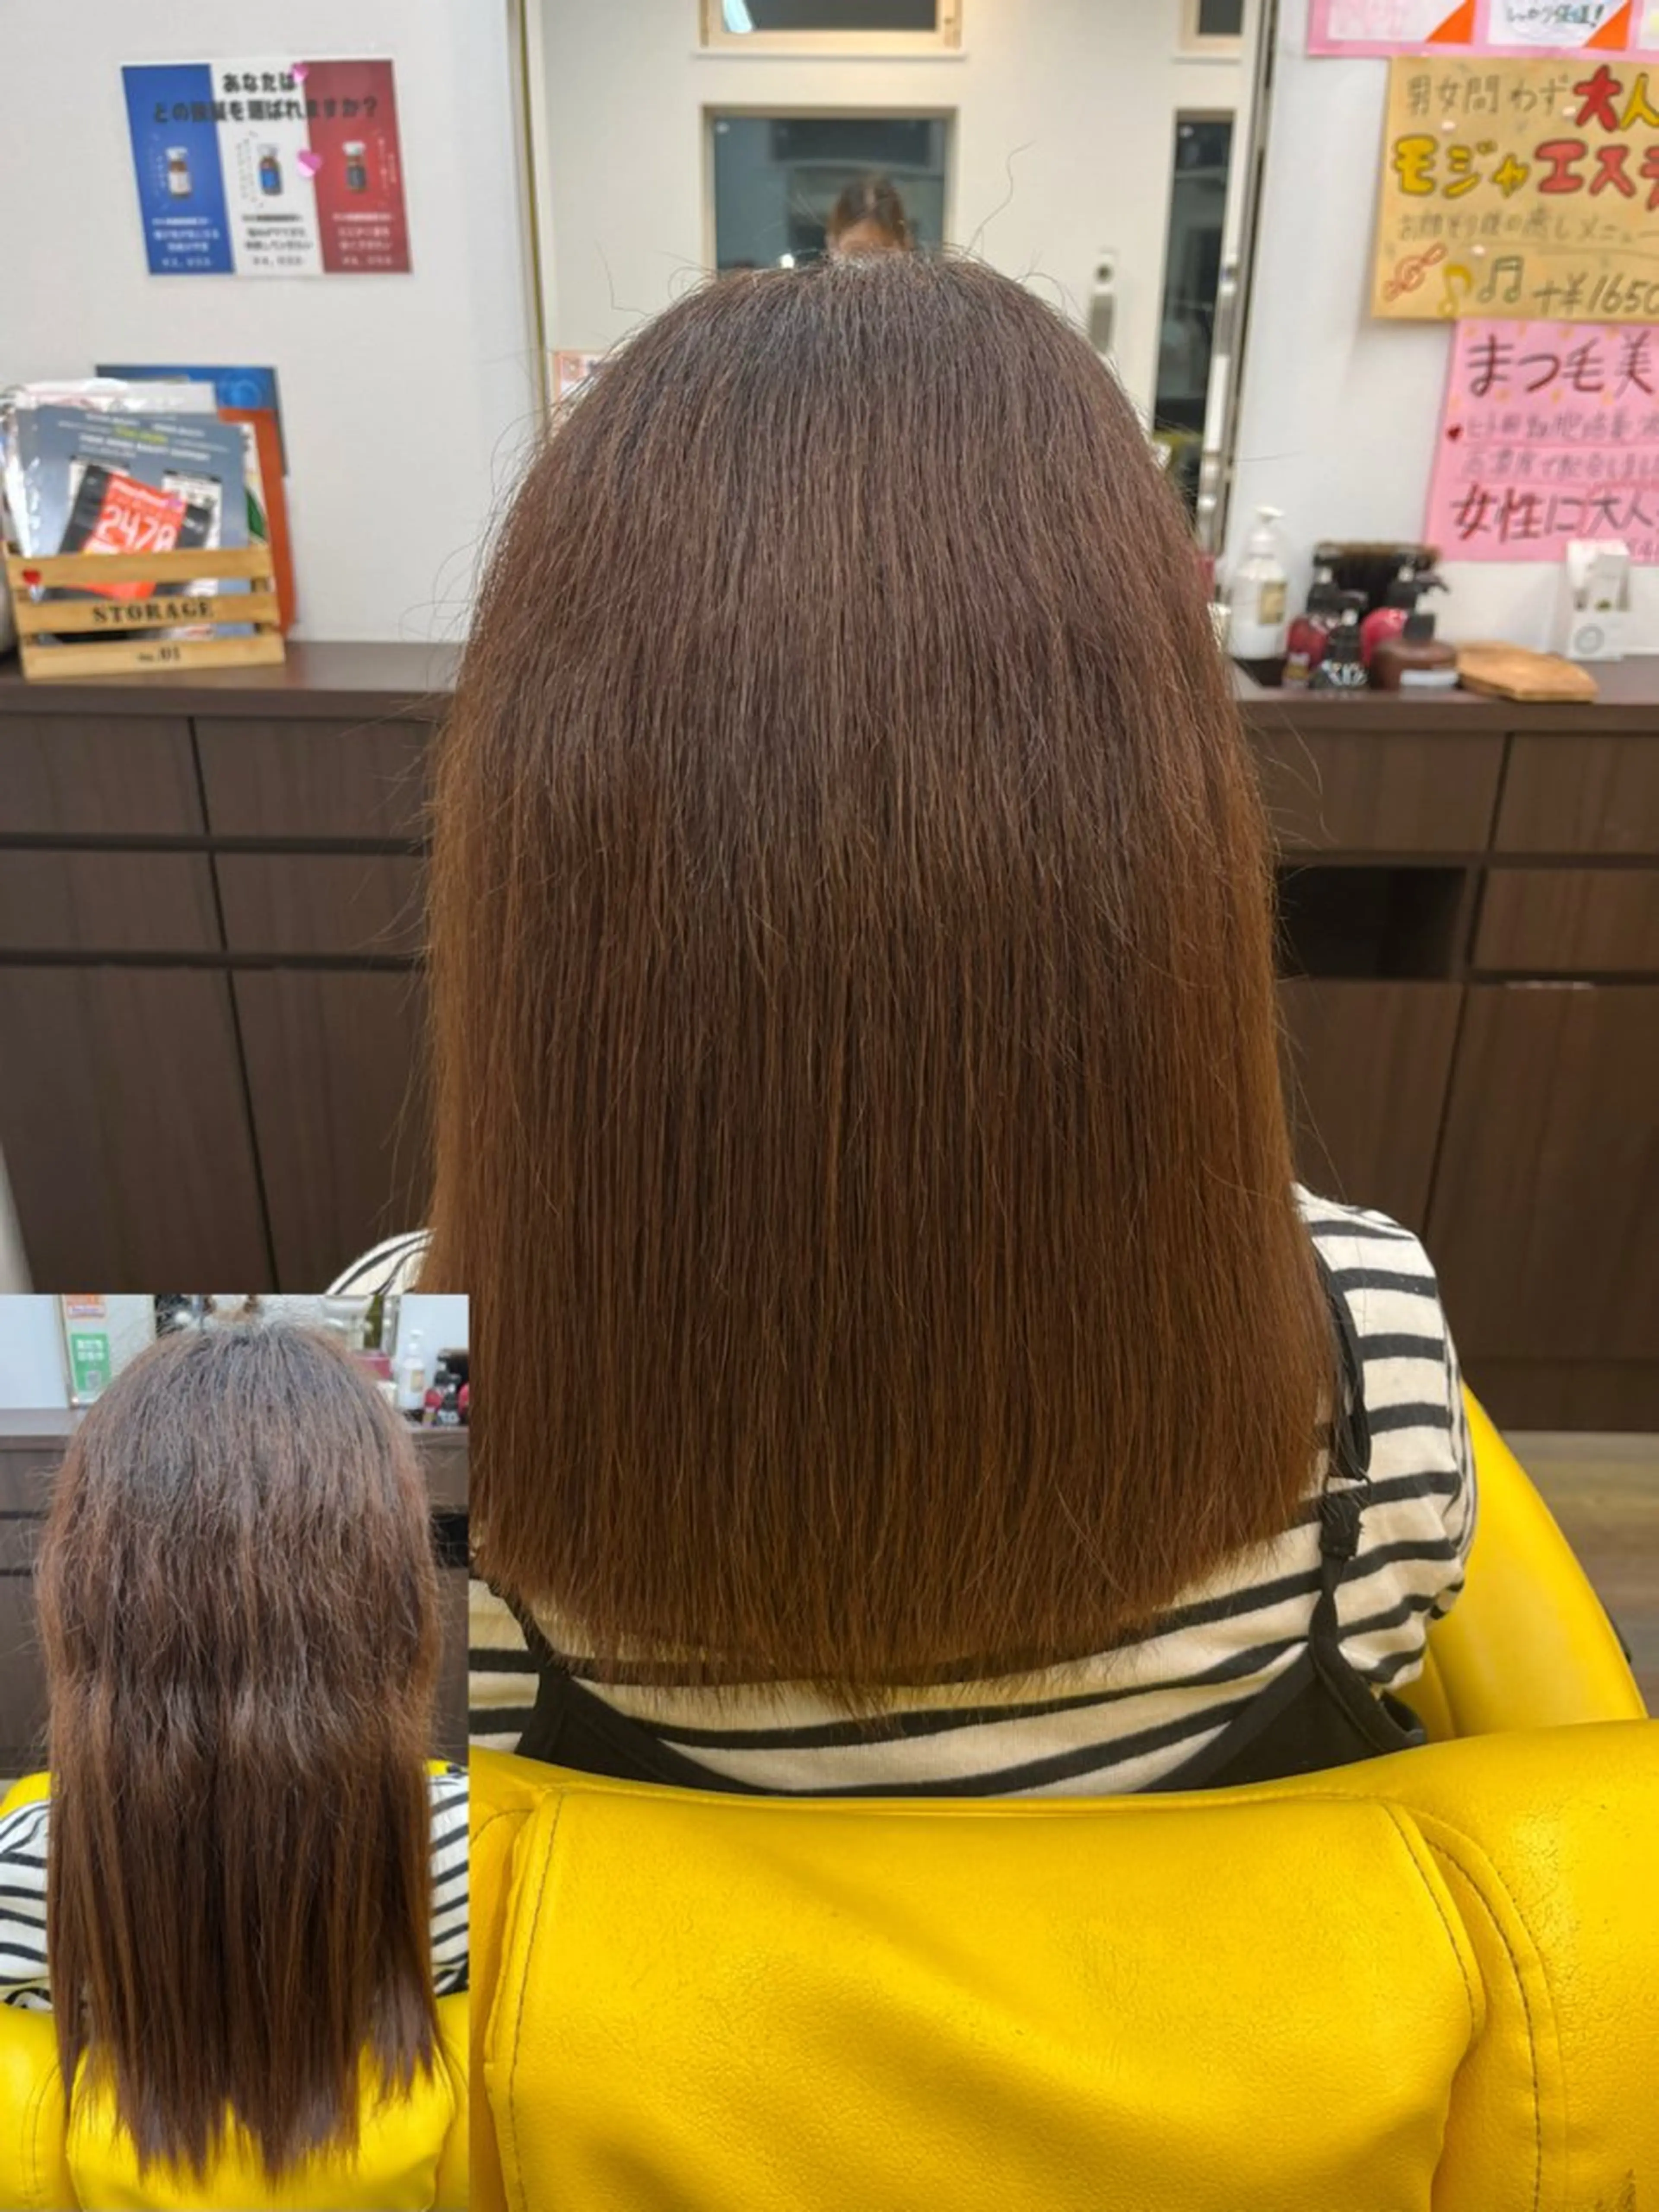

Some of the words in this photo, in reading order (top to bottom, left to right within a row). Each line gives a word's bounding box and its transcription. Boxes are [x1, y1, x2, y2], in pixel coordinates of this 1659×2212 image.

[222, 72, 297, 93] あなたは
[1467, 332, 1656, 398] まつ毛美
[92, 601, 213, 623] STORAGE
